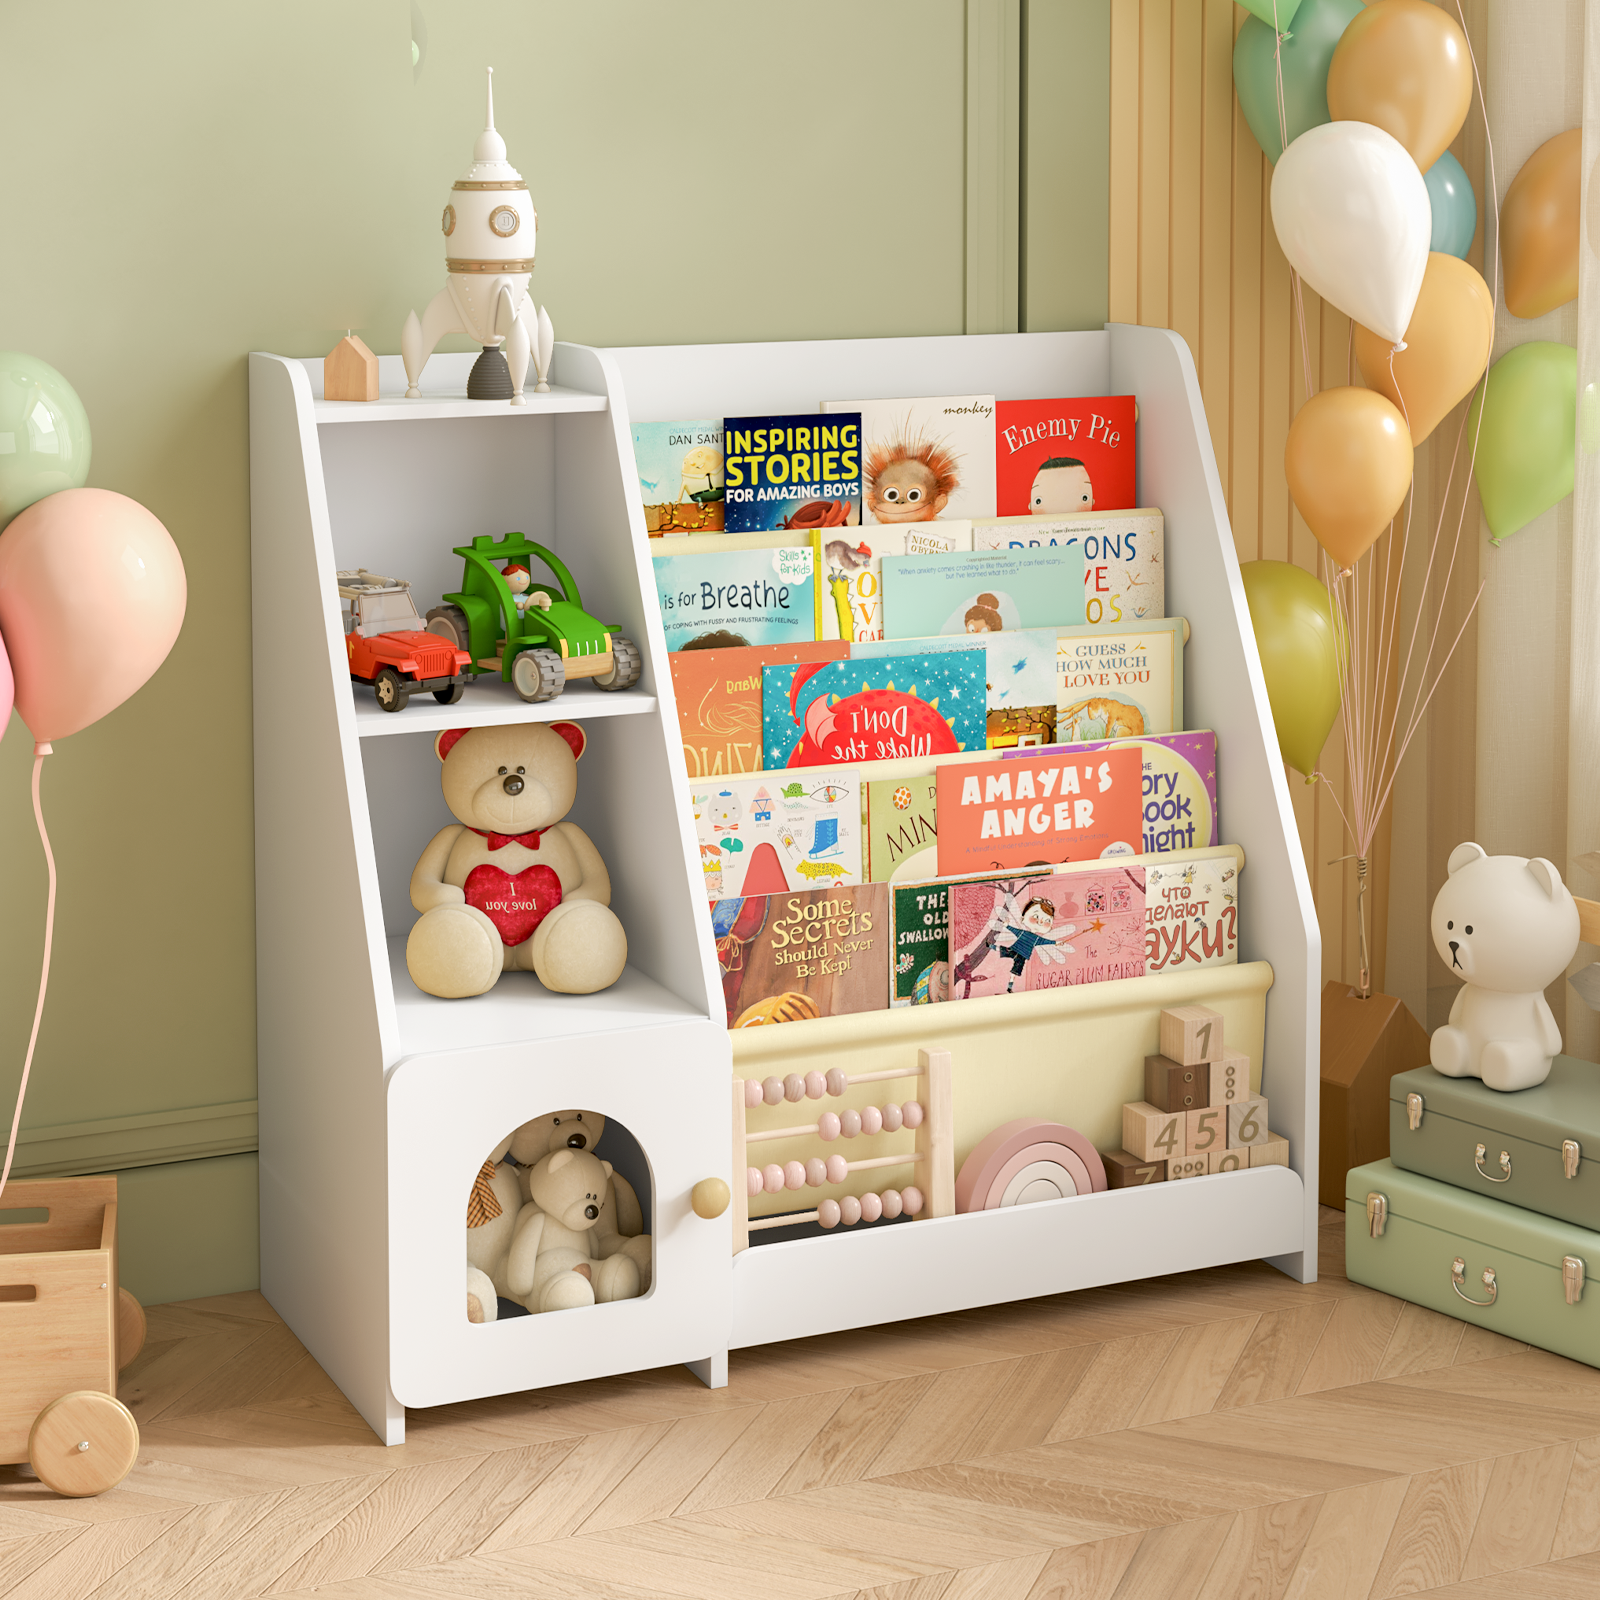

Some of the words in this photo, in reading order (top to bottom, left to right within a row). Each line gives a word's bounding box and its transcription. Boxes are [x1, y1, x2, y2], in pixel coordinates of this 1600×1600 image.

[943, 401, 993, 418] monkey
[669, 434, 692, 446] DAN
[726, 425, 858, 455] INSPIRING
[1001, 417, 1082, 455] Enemy
[1086, 413, 1121, 448] Pie
[726, 450, 859, 487] STORIES
[726, 488, 754, 504] FOR
[757, 485, 820, 502] AMAZING
[823, 482, 859, 498] BOYS
[911, 534, 949, 551] NICOLA
[779, 549, 800, 562] Skills
[780, 563, 792, 575] for
[792, 563, 811, 577] Kids
[917, 566, 936, 574] anxiety
[937, 565, 955, 573] comes
[956, 563, 979, 571] crashing
[946, 572, 955, 580] but
[966, 570, 987, 578] learned
[988, 569, 1001, 577] what
[664, 595, 674, 609] is
[678, 592, 696, 607] for
[700, 580, 790, 610] Breathe
[672, 621, 693, 629] COPING
[693, 619, 707, 627] WITH
[708, 617, 725, 625] FUSSY
[738, 616, 774, 624] FRUSTRATING
[774, 616, 799, 625] FEELINGS
[1075, 643, 1126, 657] GUESS
[1057, 659, 1093, 673] HOW
[1098, 656, 1147, 670] MUCH
[1063, 673, 1110, 688] LOVE
[1113, 670, 1150, 684] YOU
[961, 761, 1113, 806] AMAYA'S
[981, 799, 1095, 839] ANGER
[972, 844, 997, 853] Mindful
[997, 838, 1046, 850] Understanding
[1047, 837, 1054, 845] of
[1056, 836, 1078, 845] Strong
[1080, 833, 1109, 842] Emotions
[786, 898, 853, 924] Some
[771, 911, 873, 949] Secrets
[775, 942, 828, 966] Should
[833, 939, 874, 956] Never
[1084, 944, 1098, 959] The
[796, 964, 817, 978] Be
[820, 954, 852, 976] Kept
[1036, 969, 1073, 990] SUGAR
[1076, 964, 1104, 985] PLUM
[1196, 1022, 1212, 1060] 1
[1195, 1111, 1219, 1150] 5
[1238, 1105, 1260, 1143] 6
[1153, 1118, 1178, 1155] 4
